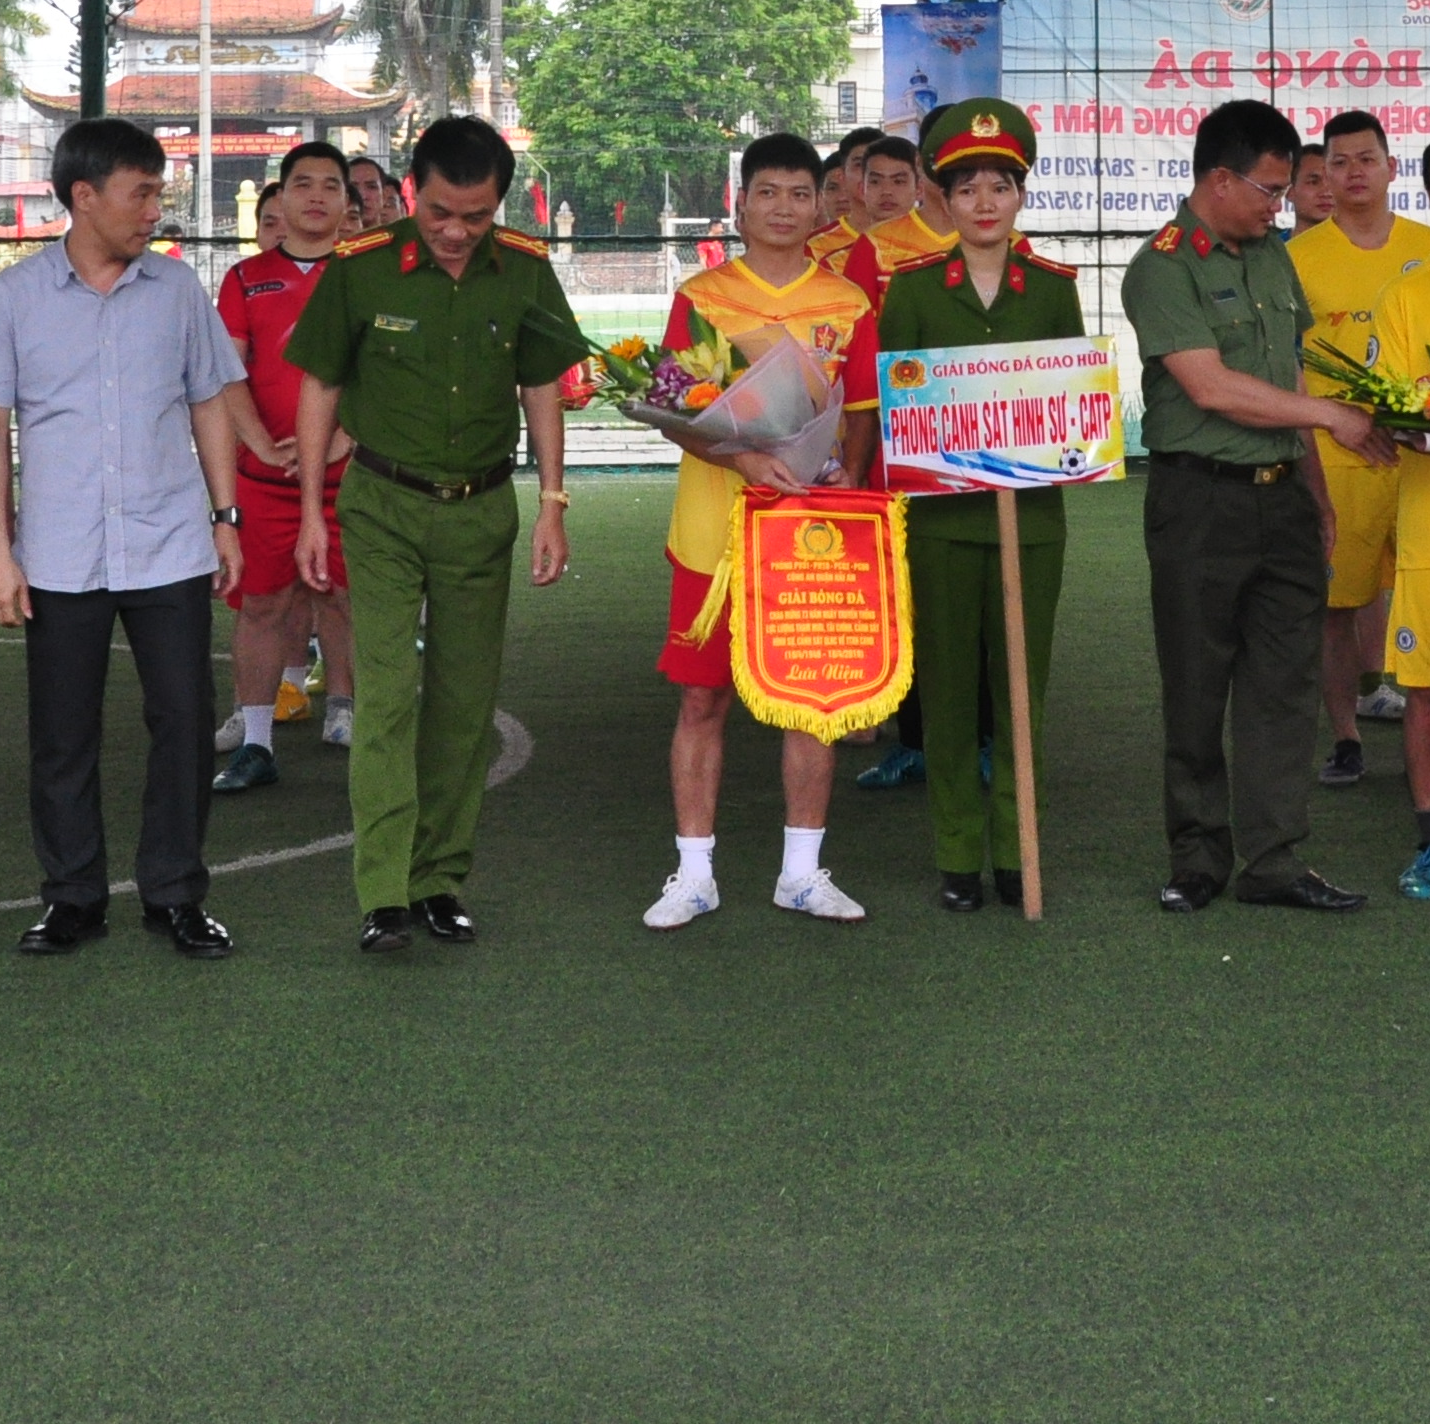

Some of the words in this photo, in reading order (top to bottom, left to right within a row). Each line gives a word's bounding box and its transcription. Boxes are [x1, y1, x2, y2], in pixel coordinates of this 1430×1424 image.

[932, 360, 964, 378] GIẢI
[967, 357, 1010, 375] BÓNG
[1013, 355, 1033, 372] ĐÁ
[1036, 354, 1073, 370] GIAO
[1077, 349, 1108, 366] HỮU
[890, 395, 939, 456] PHÒNG
[941, 387, 980, 452] CẢNH
[982, 390, 1008, 449] SÁT
[1011, 388, 1046, 447] HÌNH
[1048, 390, 1068, 454] SỰ
[1079, 392, 1112, 442] CATP
[778, 587, 807, 605] GIẢI
[809, 588, 844, 605] BÓNG
[846, 589, 866, 605] ĐÁ
